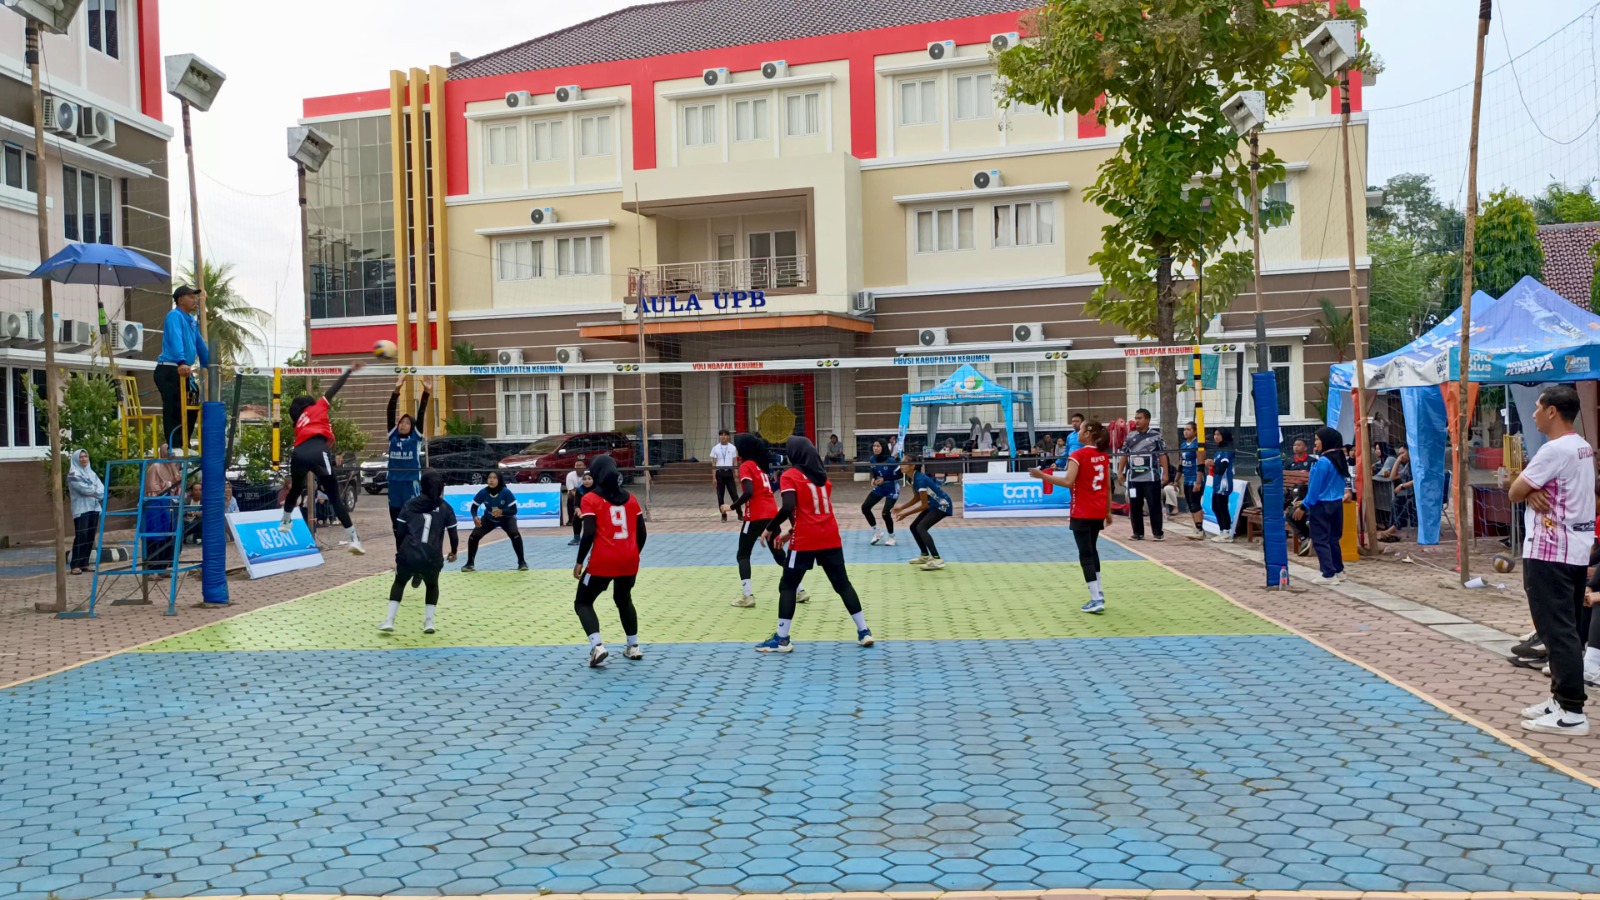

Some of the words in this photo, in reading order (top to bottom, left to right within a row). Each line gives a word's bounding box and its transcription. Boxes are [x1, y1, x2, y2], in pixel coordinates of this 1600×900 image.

[633, 293, 703, 313] AULA
[712, 290, 766, 309] UPB
[1140, 347, 1166, 355] NGAPAK
[1168, 346, 1194, 354] KEBUME
[469, 366, 490, 374] PBVSI
[491, 365, 531, 373] KABUPATEN
[532, 365, 564, 373] KEBUMEN
[893, 357, 914, 365] PBVSI
[915, 356, 957, 364] KABUPATEN
[1505, 361, 1554, 376] PLUSNYA
[1506, 353, 1554, 369] NONSTOP
[287, 367, 312, 375] NGAPAK
[313, 367, 342, 375] KEBUMEN
[1092, 464, 1104, 491] 2
[807, 482, 830, 515] 11
[421, 513, 432, 544] 1
[610, 505, 629, 540] 9
[269, 528, 298, 548] BNI
